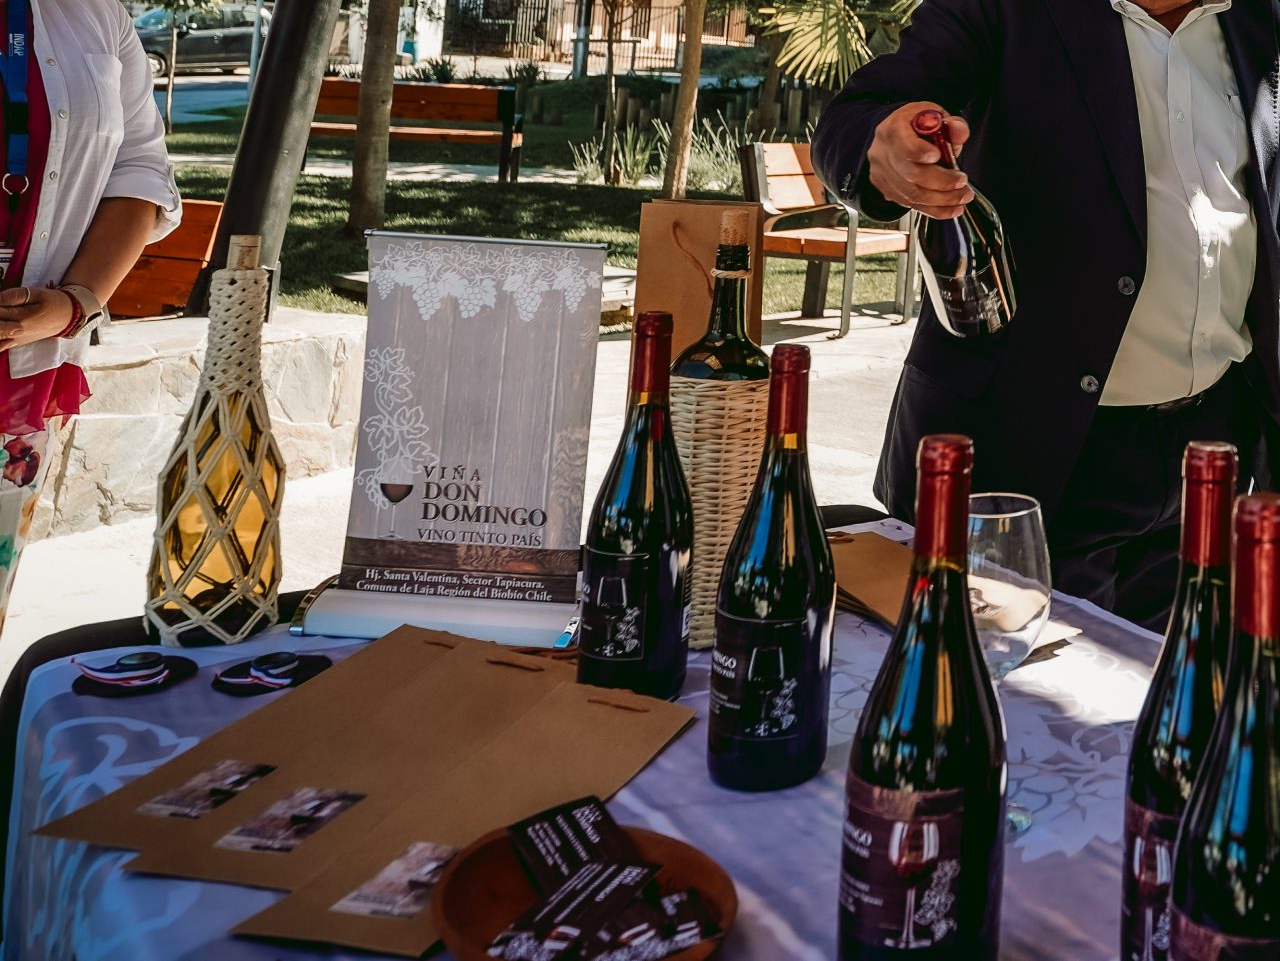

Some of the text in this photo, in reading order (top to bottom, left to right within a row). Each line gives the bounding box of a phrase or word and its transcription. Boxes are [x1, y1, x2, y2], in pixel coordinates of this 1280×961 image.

[13, 33, 25, 57] INDAP
[423, 465, 480, 481] VIÑA
[422, 482, 482, 502] DON
[421, 502, 548, 527] DOMINGO
[417, 528, 542, 546] VINO TINTO PAÍS
[383, 570, 410, 581] Santa
[412, 571, 460, 585] Valentina,
[462, 574, 493, 586] Sector
[494, 576, 545, 590] Tapiacura.
[356, 580, 397, 592] Comuna
[399, 582, 412, 593] de
[414, 583, 434, 596] Laja
[437, 585, 470, 598] Región
[473, 586, 488, 598] del
[525, 589, 552, 602] Chile
